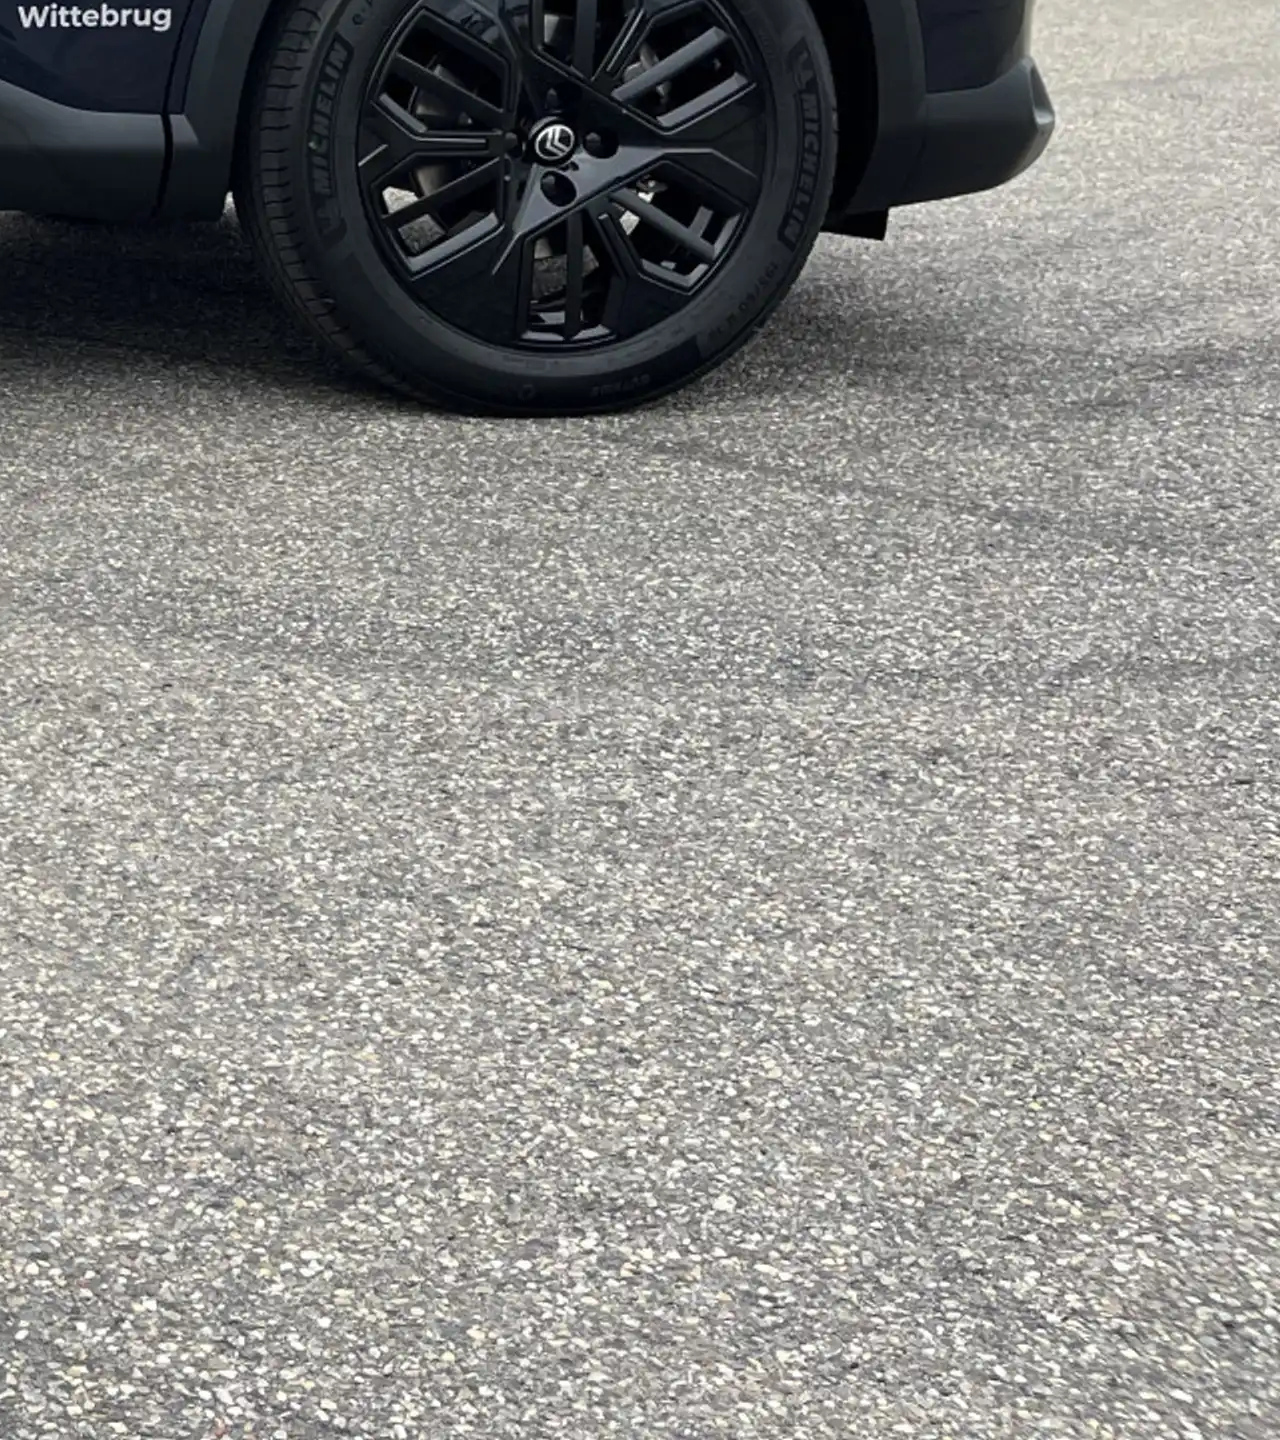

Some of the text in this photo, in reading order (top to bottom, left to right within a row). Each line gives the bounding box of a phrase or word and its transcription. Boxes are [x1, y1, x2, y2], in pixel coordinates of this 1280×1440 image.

[17, 2, 172, 32] Wittebrug
[310, 40, 348, 197] MICHELIN
[783, 93, 821, 242] MICHELIN
